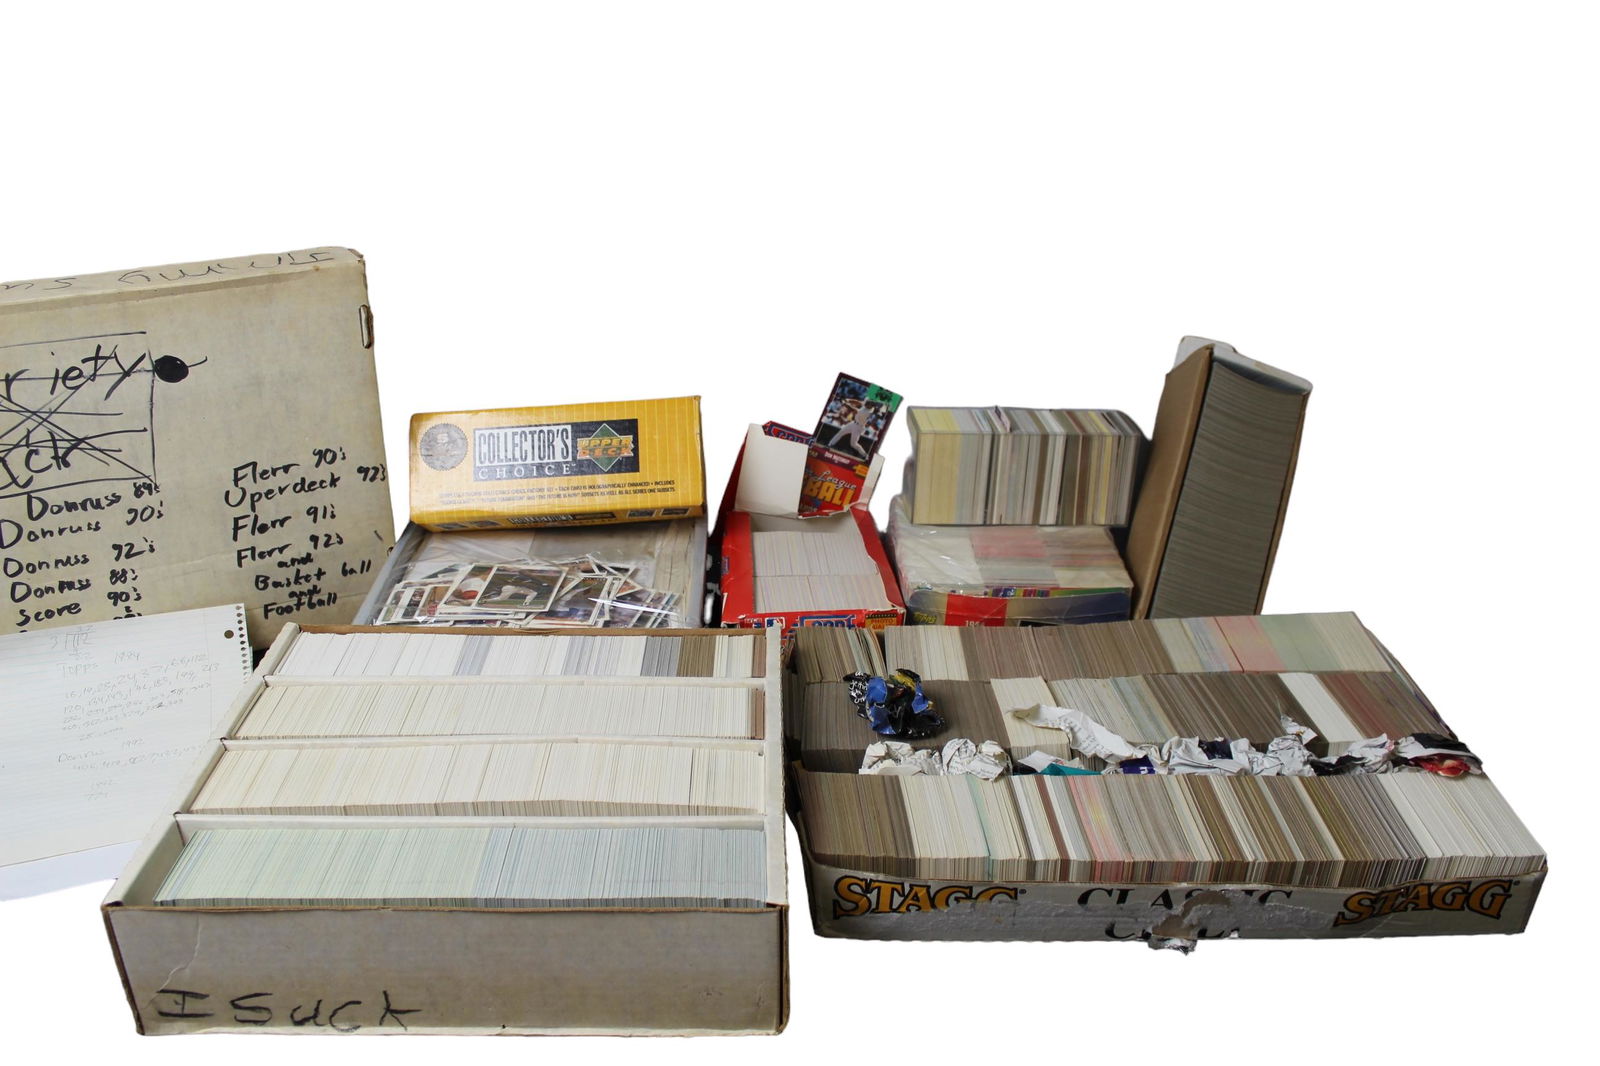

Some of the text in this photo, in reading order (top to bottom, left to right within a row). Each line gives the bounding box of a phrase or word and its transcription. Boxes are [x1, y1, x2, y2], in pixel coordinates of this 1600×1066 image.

[477, 427, 571, 465] COLLECTOR'S
[578, 436, 633, 449] UPPER
[478, 464, 572, 480] CHOICE
[224, 471, 341, 513] Uperdeck
[0, 519, 101, 549] Donruss
[255, 567, 326, 591] Basket
[263, 592, 338, 620] Football
[1333, 879, 1513, 927] STAGG
